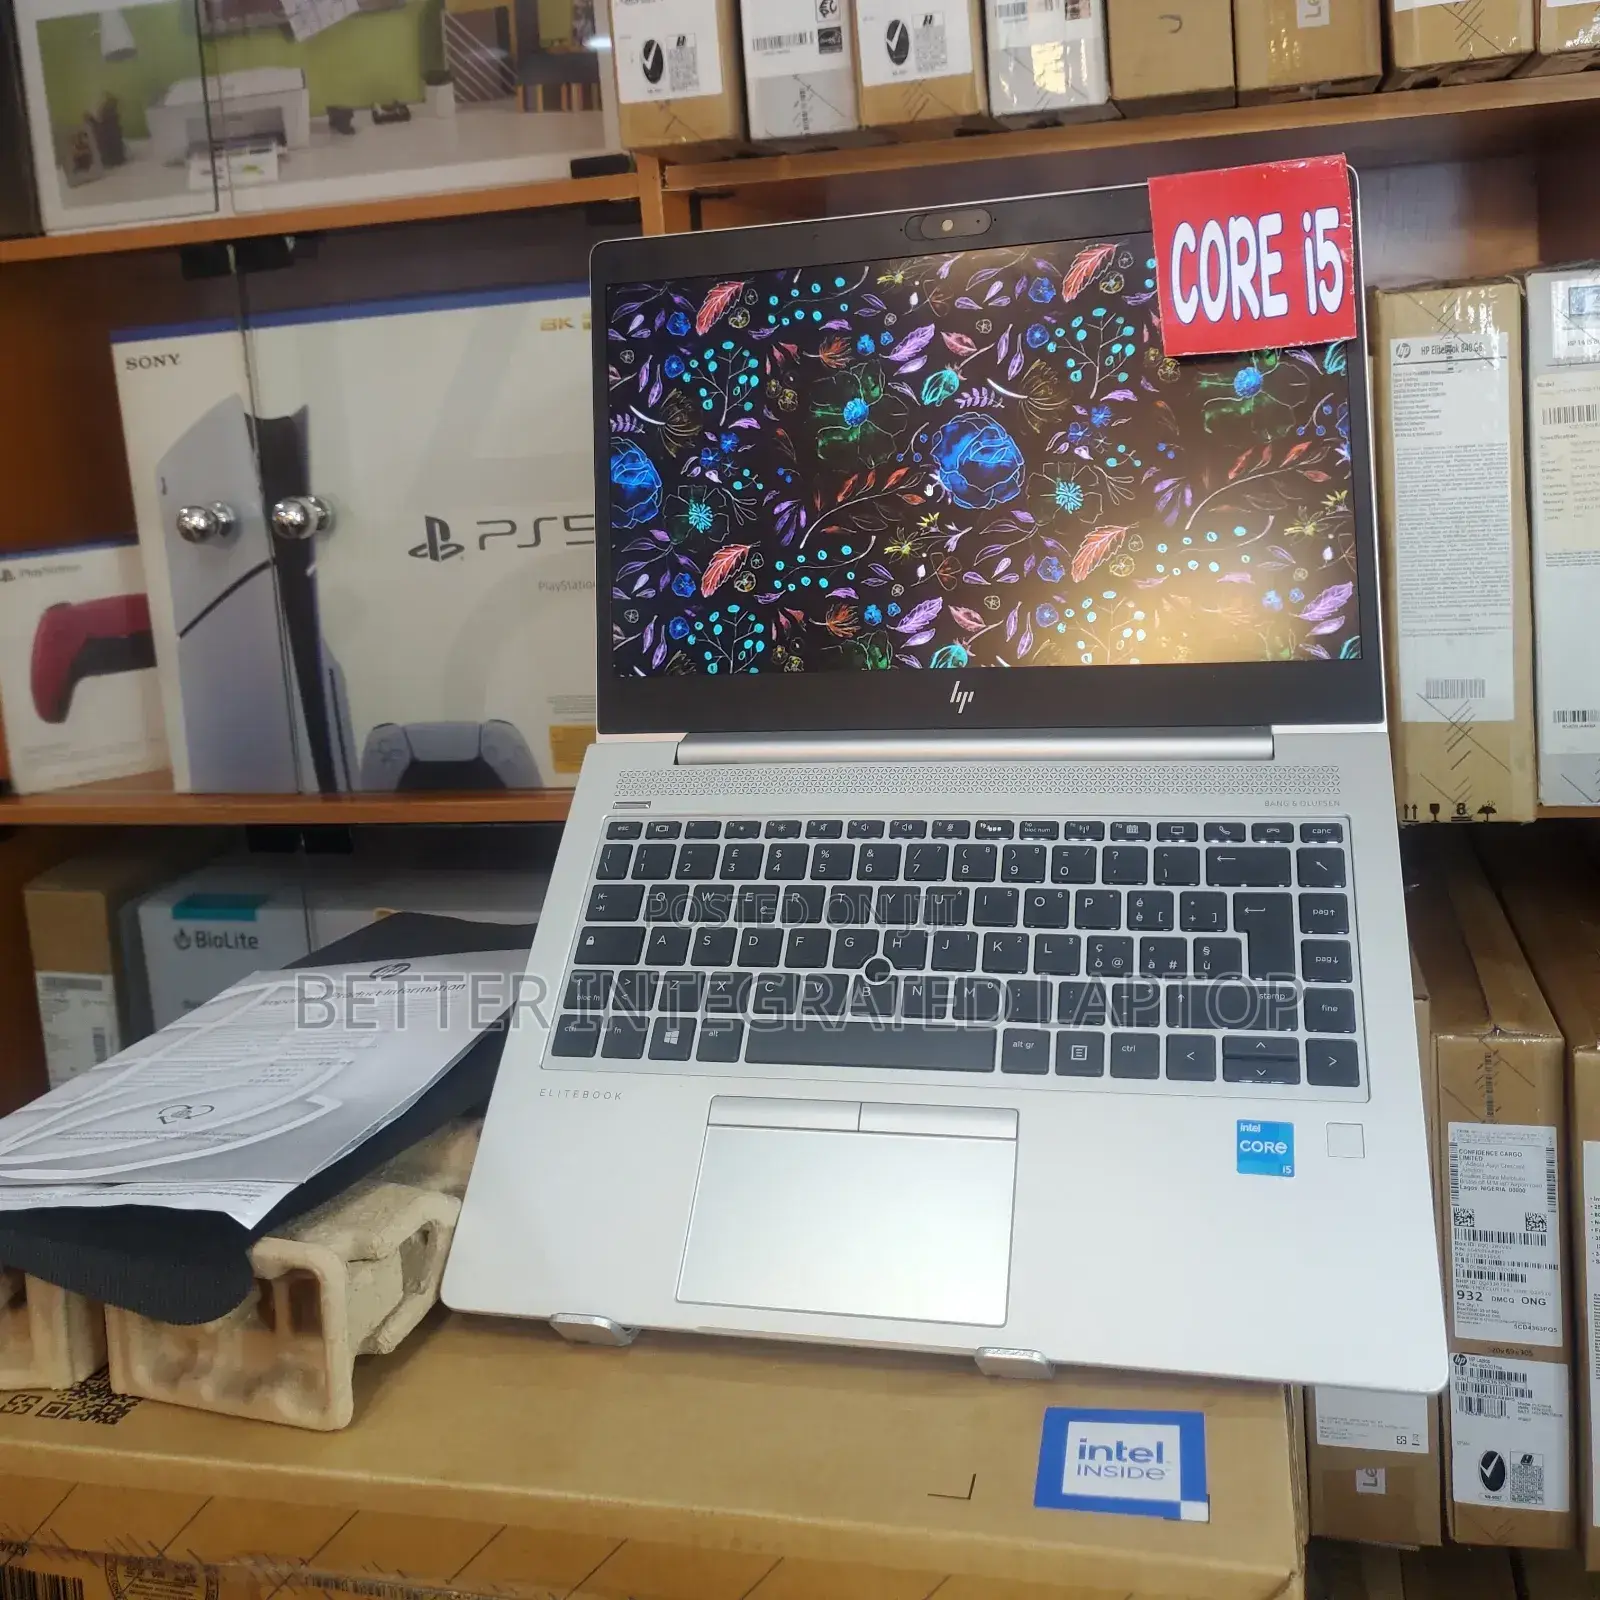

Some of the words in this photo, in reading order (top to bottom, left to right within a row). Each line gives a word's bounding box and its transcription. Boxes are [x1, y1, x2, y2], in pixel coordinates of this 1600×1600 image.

[1171, 212, 1289, 325] CORE
[1302, 206, 1345, 316] i5
[1421, 346, 1430, 356] HP
[125, 353, 181, 371] SONY
[476, 513, 596, 551] PS5
[538, 579, 596, 593] PlayStatio
[950, 680, 975, 714] hp
[640, 864, 645, 872] 1
[683, 864, 691, 872] 2
[727, 863, 735, 872] 3
[773, 864, 781, 872] 4
[818, 864, 827, 873] 5
[865, 864, 873, 873] 6
[913, 864, 921, 873] 7
[961, 865, 970, 874] 8
[1010, 865, 1019, 875] 9
[655, 892, 666, 902] Q
[701, 892, 714, 902] W
[745, 892, 754, 902] E
[791, 893, 800, 903] R
[838, 893, 846, 903] T
[886, 893, 896, 903] Y
[934, 894, 944, 904] U
[1084, 898, 1094, 908] P
[196, 930, 259, 949] BioLite
[656, 934, 667, 945] A
[703, 935, 712, 946] S
[748, 936, 759, 946] D
[795, 936, 804, 947] F
[844, 937, 855, 947] G
[892, 938, 902, 948] H
[941, 939, 950, 950] J
[993, 941, 1003, 952] K
[1044, 942, 1052, 953] L
[382, 983, 467, 997] Information
[669, 980, 680, 990] Z
[716, 981, 727, 992] X
[764, 982, 774, 992] C
[814, 982, 824, 993] V
[862, 987, 871, 997] B
[912, 986, 923, 996] N
[964, 987, 975, 998] M
[1259, 992, 1286, 1001] stamp
[1321, 1004, 1338, 1012] fine
[614, 1026, 622, 1034] fn
[1012, 1039, 1023, 1048] alt
[1025, 1042, 1035, 1050] gr
[539, 1088, 623, 1101] ELITEBOOK
[1240, 1122, 1261, 1133] intel
[1458, 1148, 1498, 1157] CONFIDENCE
[1499, 1150, 1523, 1158] CARGO
[1282, 1165, 1292, 1174] i5
[1480, 1185, 1506, 1193] NIGERIA
[1456, 1290, 1484, 1302] 932
[1491, 1296, 1515, 1304] DMCQ
[1521, 1296, 1547, 1306] ONG
[1078, 1437, 1164, 1465] intel
